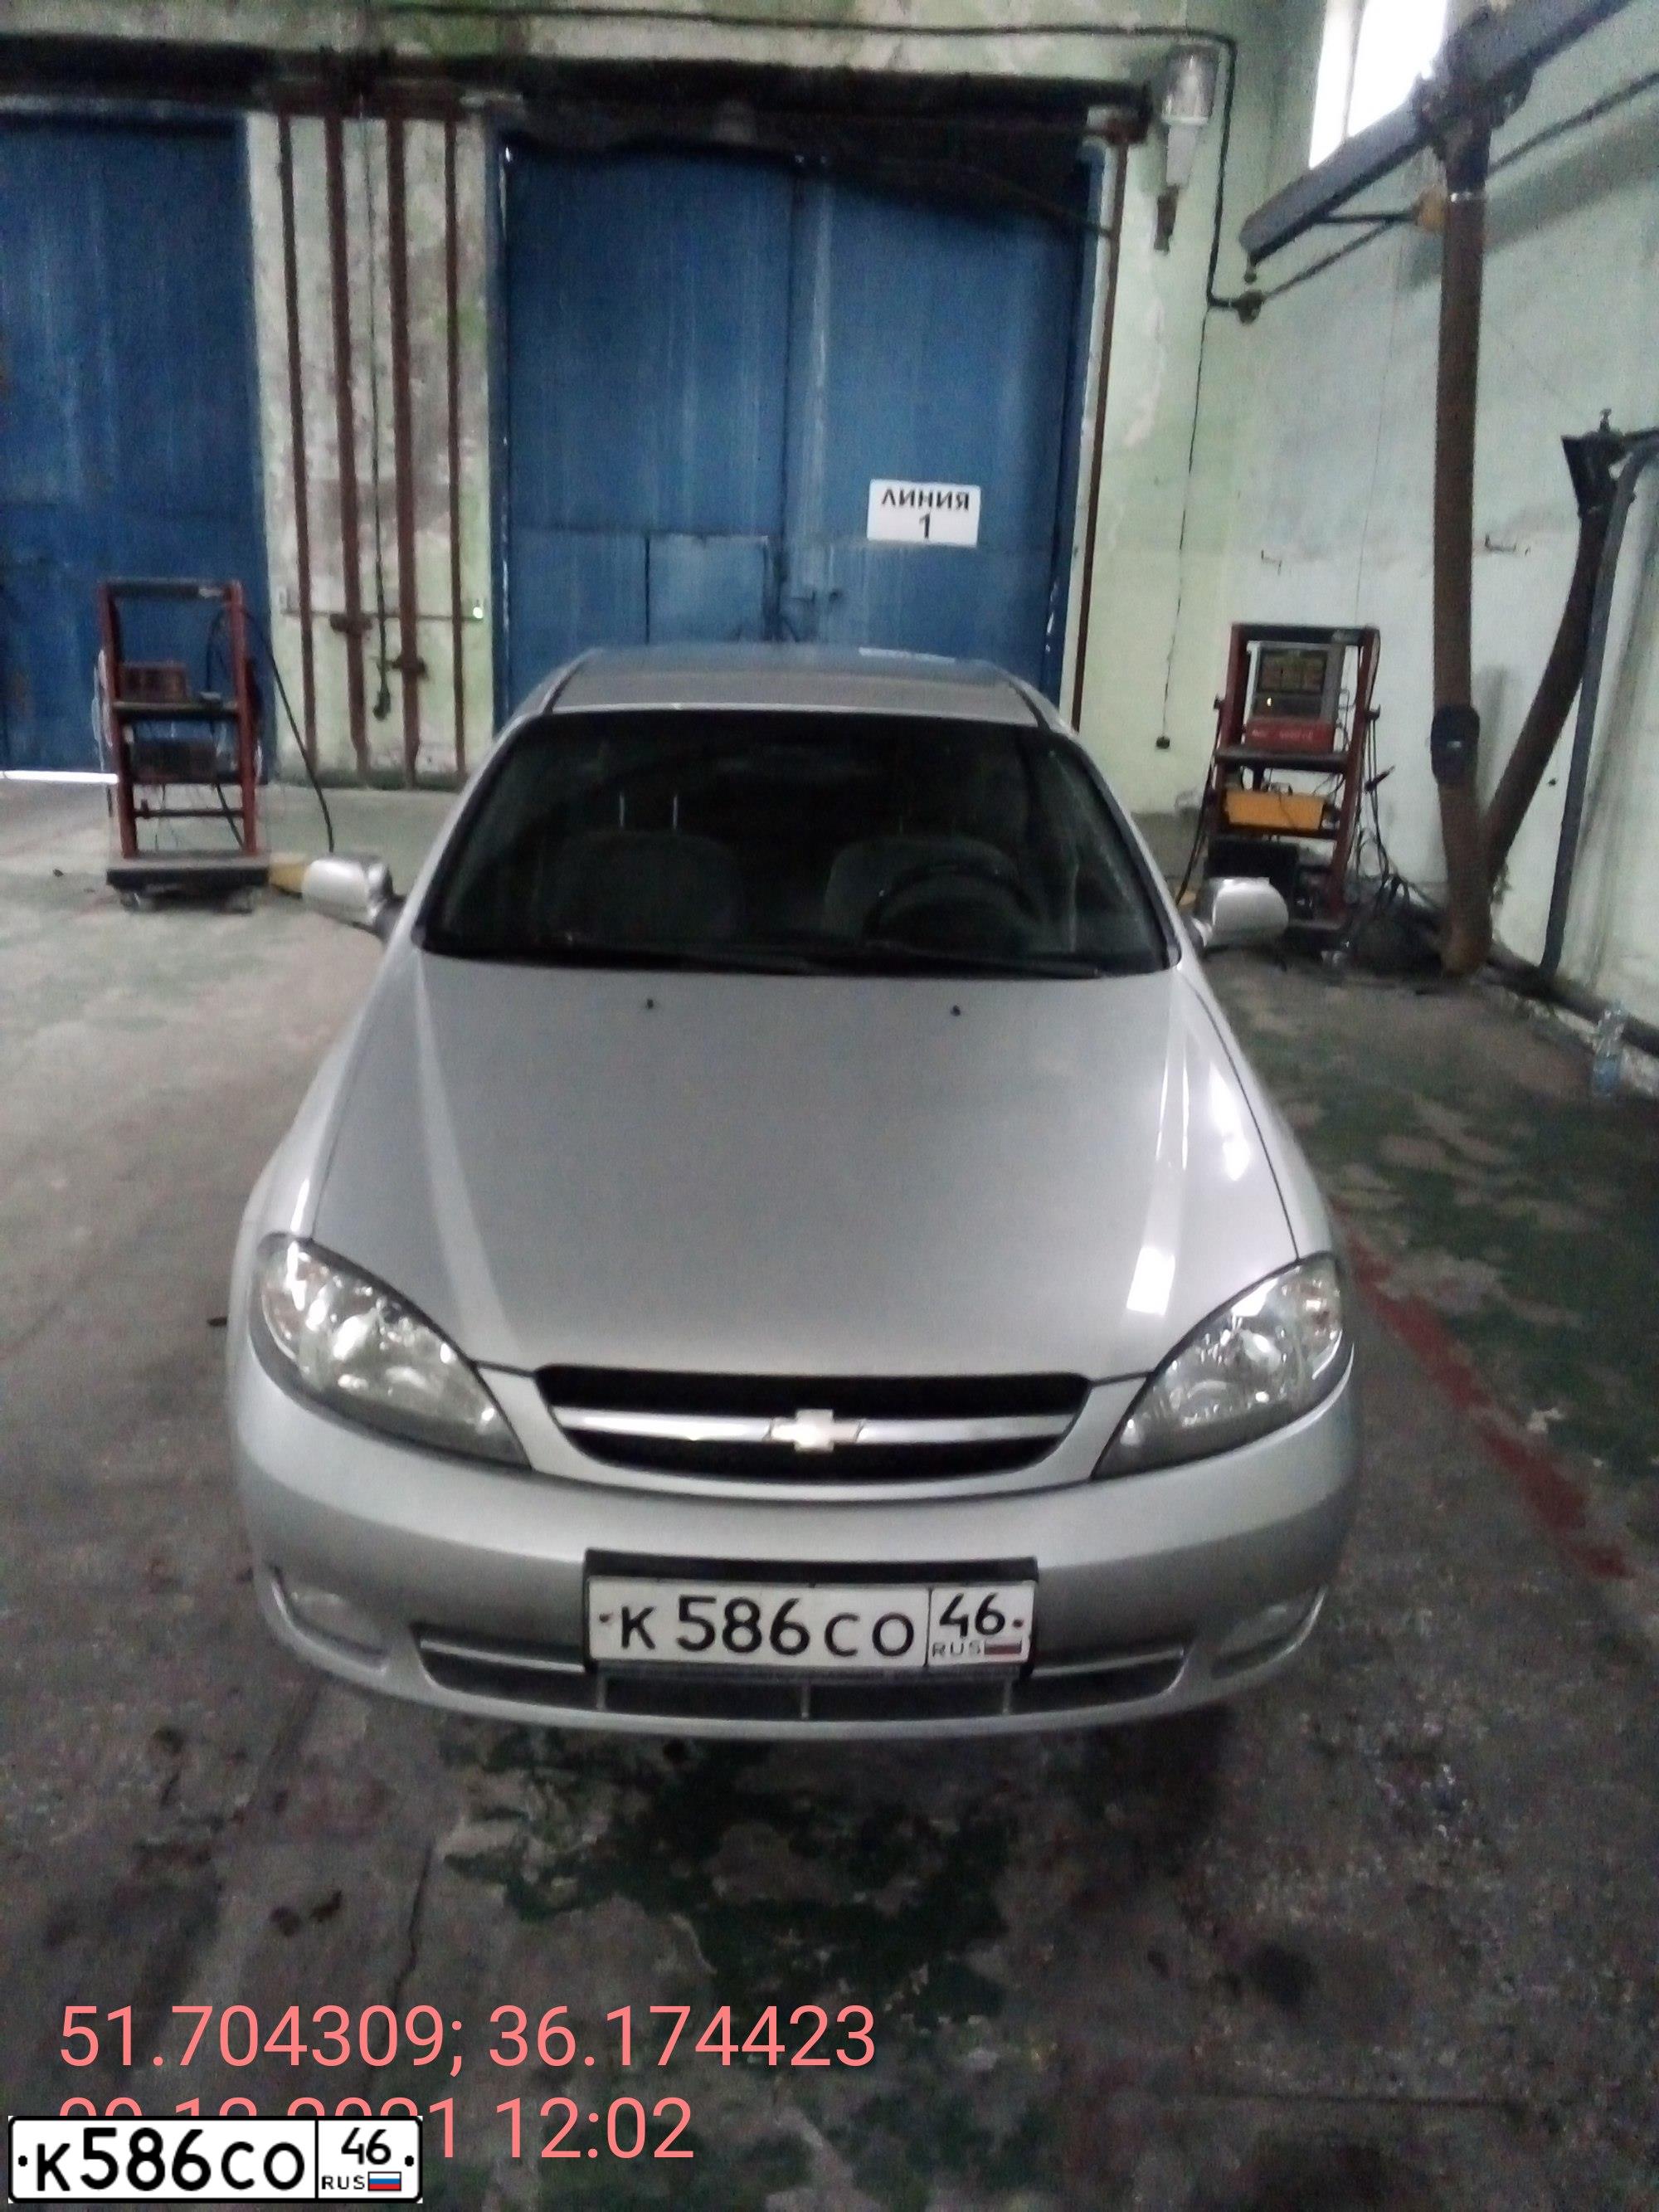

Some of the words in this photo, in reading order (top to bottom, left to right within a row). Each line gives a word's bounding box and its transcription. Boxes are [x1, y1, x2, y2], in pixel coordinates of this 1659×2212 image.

[881, 488, 970, 511] ЛИНИЯ
[919, 513, 931, 538] 1
[939, 1592, 1005, 1638] 46
[932, 1640, 980, 1658] RUS
